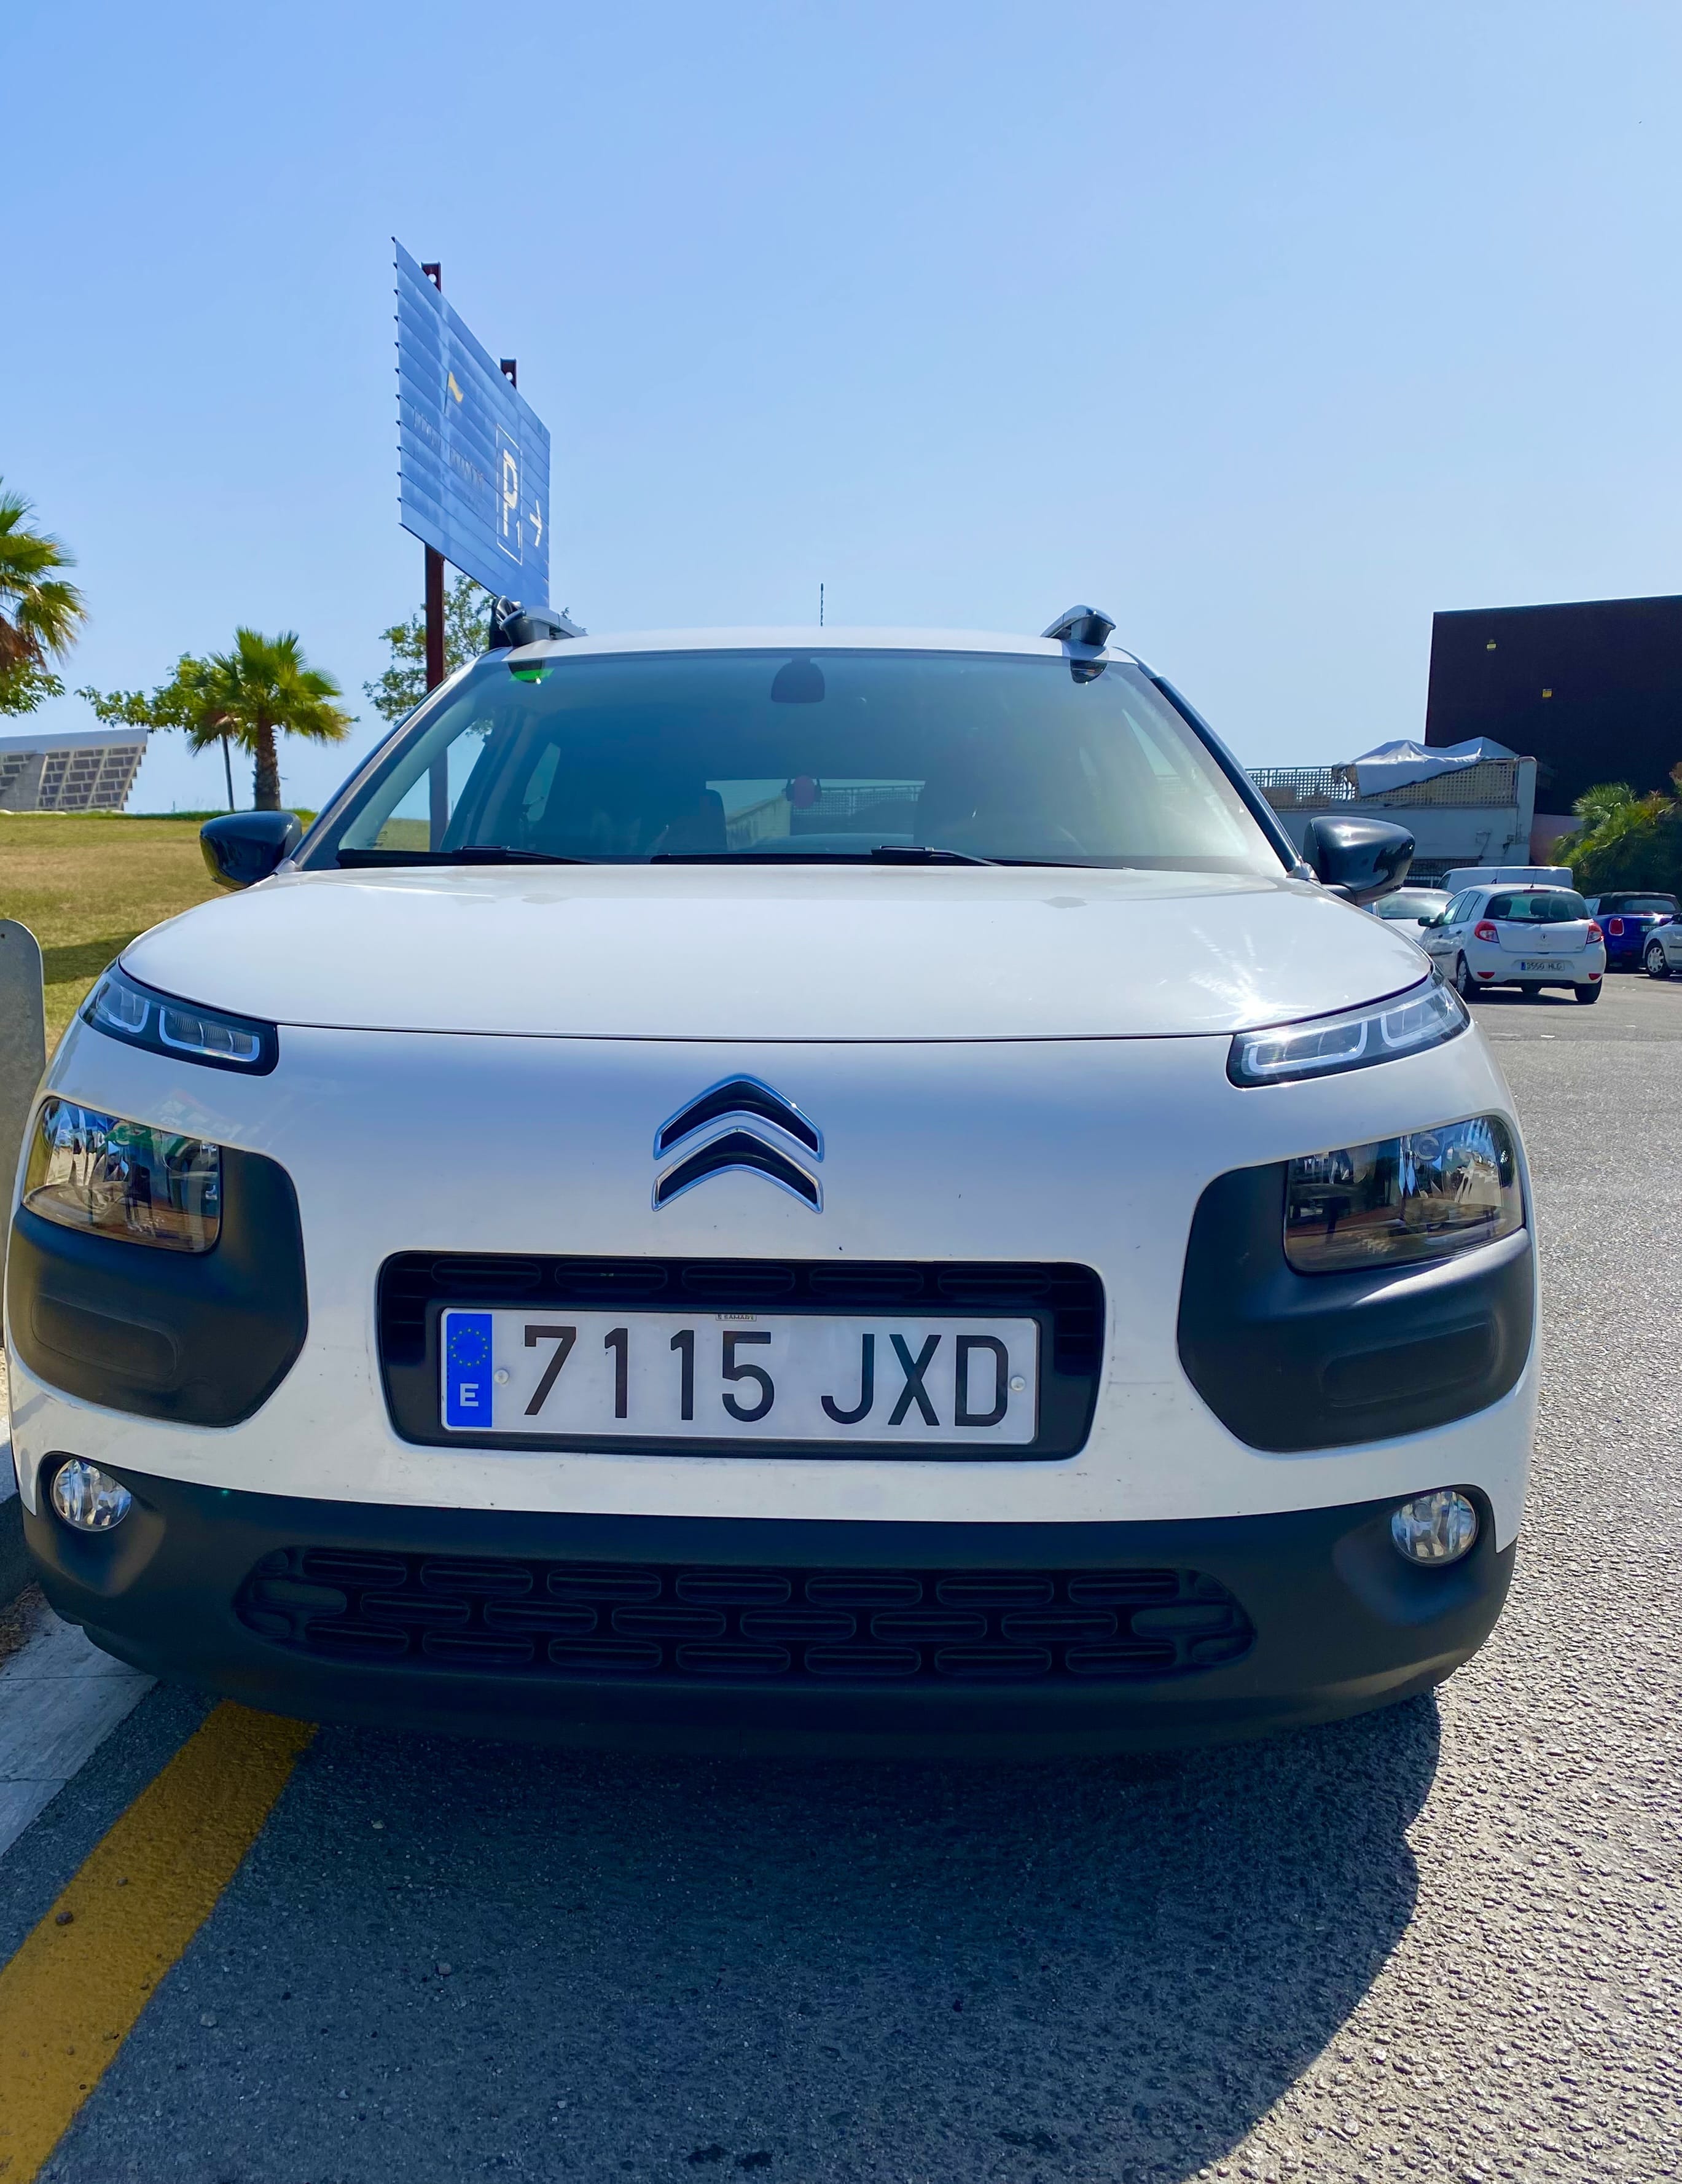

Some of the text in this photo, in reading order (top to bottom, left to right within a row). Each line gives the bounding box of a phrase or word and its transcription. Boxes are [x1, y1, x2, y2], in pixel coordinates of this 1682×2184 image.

[460, 1384, 479, 1406] E
[525, 1326, 1008, 1426] 7115 JXD
